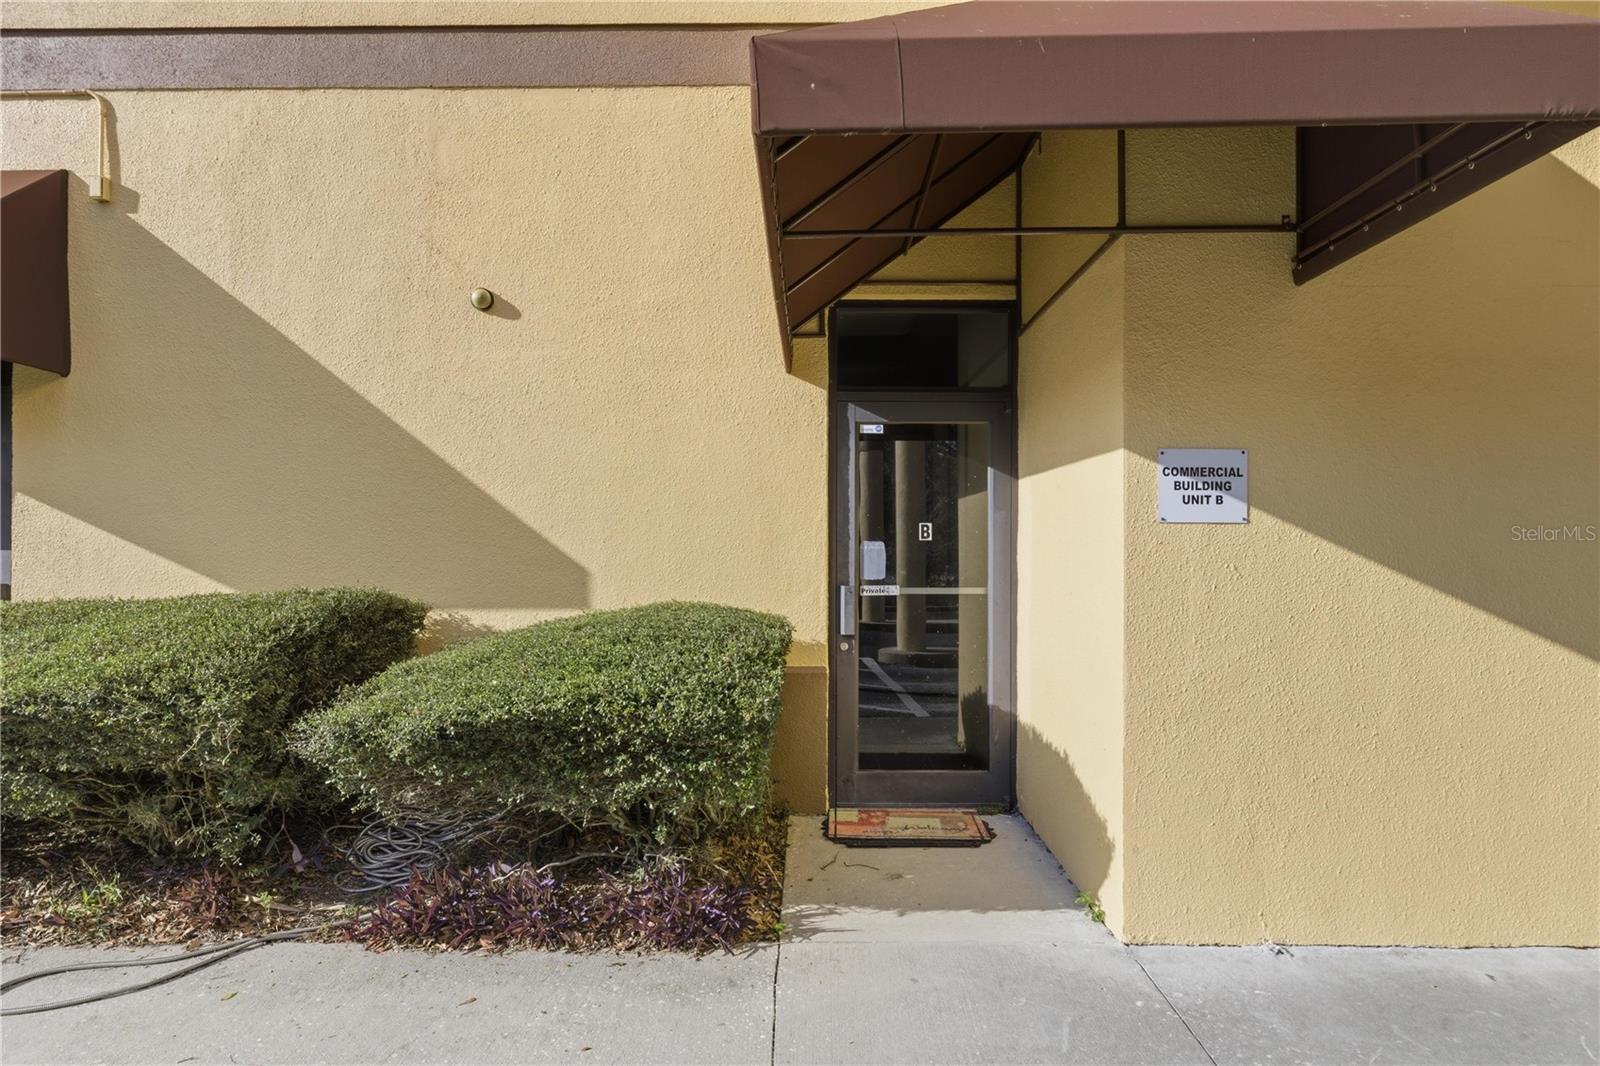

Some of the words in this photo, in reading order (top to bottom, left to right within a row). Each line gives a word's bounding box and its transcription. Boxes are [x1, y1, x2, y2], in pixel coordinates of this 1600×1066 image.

[1162, 466, 1244, 478] COMMERCIAL
[1173, 480, 1232, 491] BUILDING
[1182, 494, 1212, 505] UNIT
[1215, 495, 1224, 505] B
[920, 524, 931, 540] B
